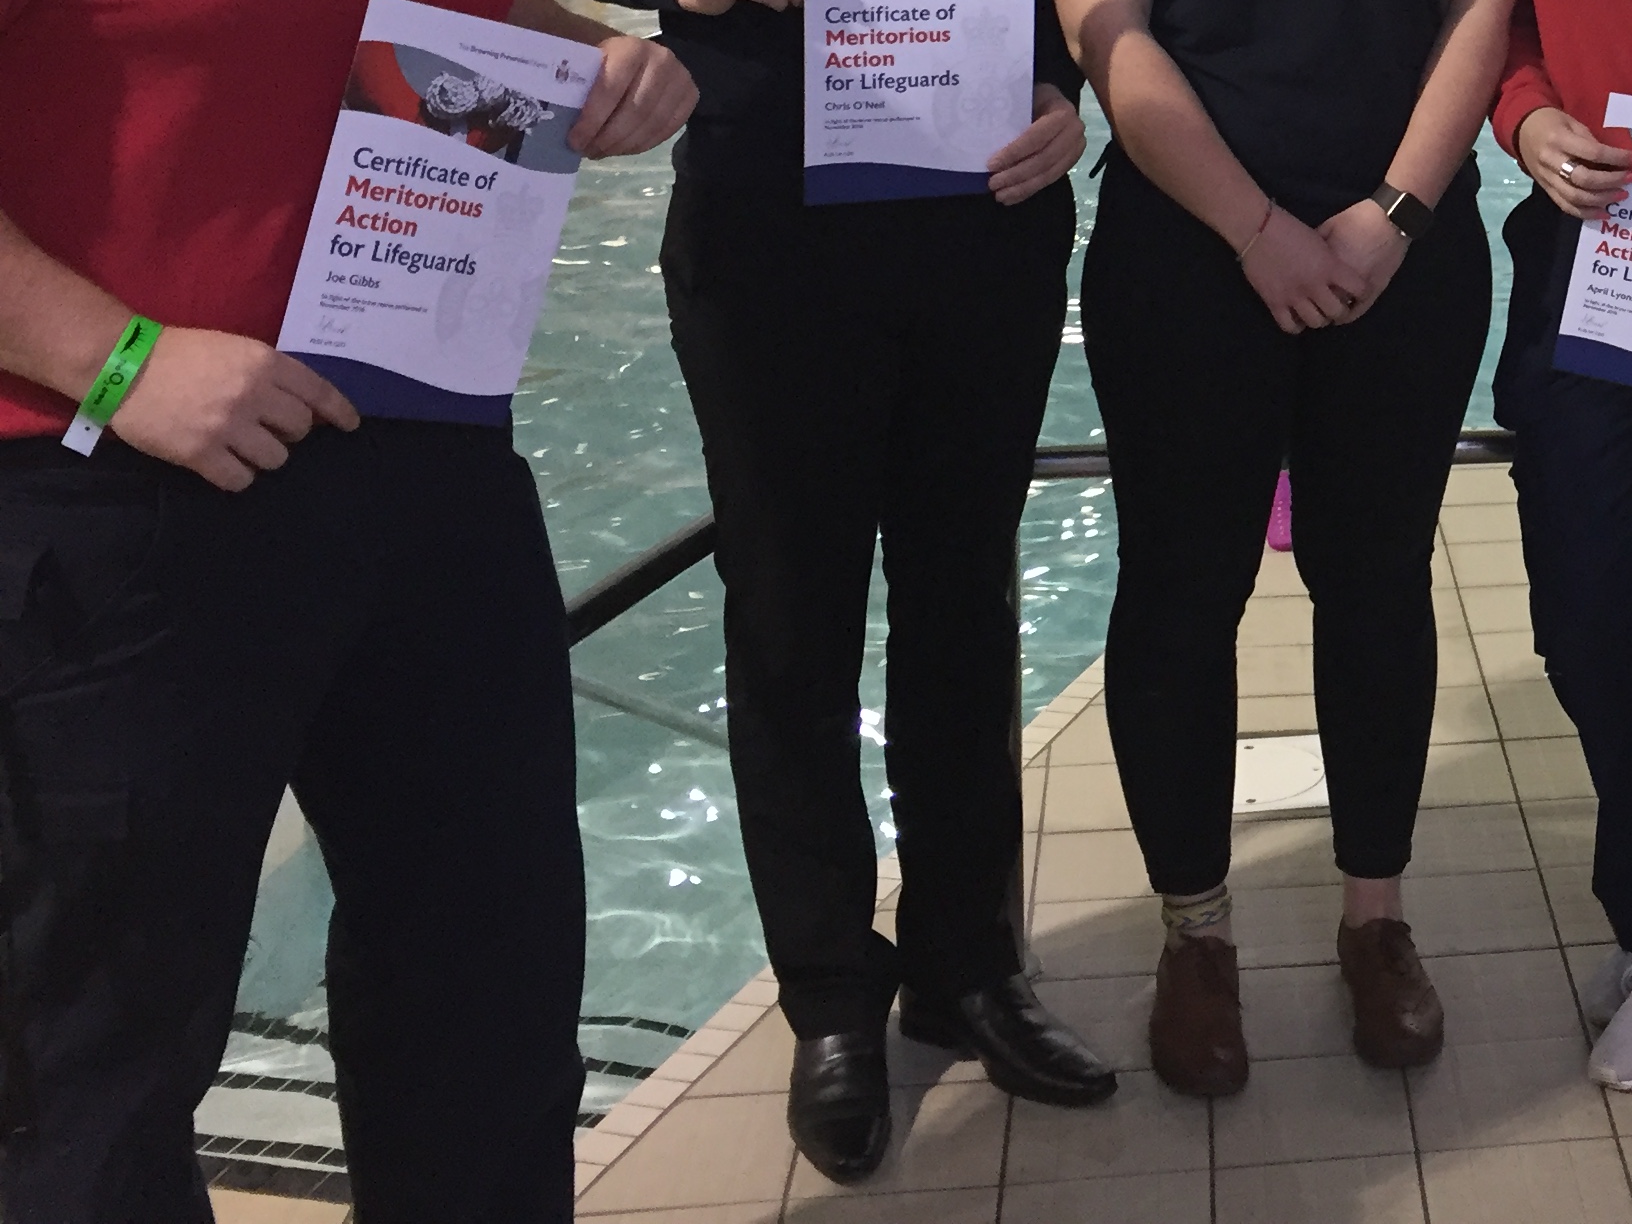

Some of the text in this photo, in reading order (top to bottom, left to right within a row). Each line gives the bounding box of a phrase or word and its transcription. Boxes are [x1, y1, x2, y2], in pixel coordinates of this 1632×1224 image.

[825, 4, 956, 24] Certificate of
[826, 28, 951, 46] Meritorious
[825, 51, 894, 69] Action
[825, 70, 960, 93] for Lifeguards
[825, 102, 850, 111] Chris
[353, 147, 498, 191] Certificate of
[345, 175, 483, 218] Meritorious
[335, 206, 418, 237] Action
[330, 235, 477, 276] for Lifeguards
[1592, 260, 1618, 277] for
[326, 271, 381, 288] Joe Gibbs
[1587, 284, 1609, 295] April
